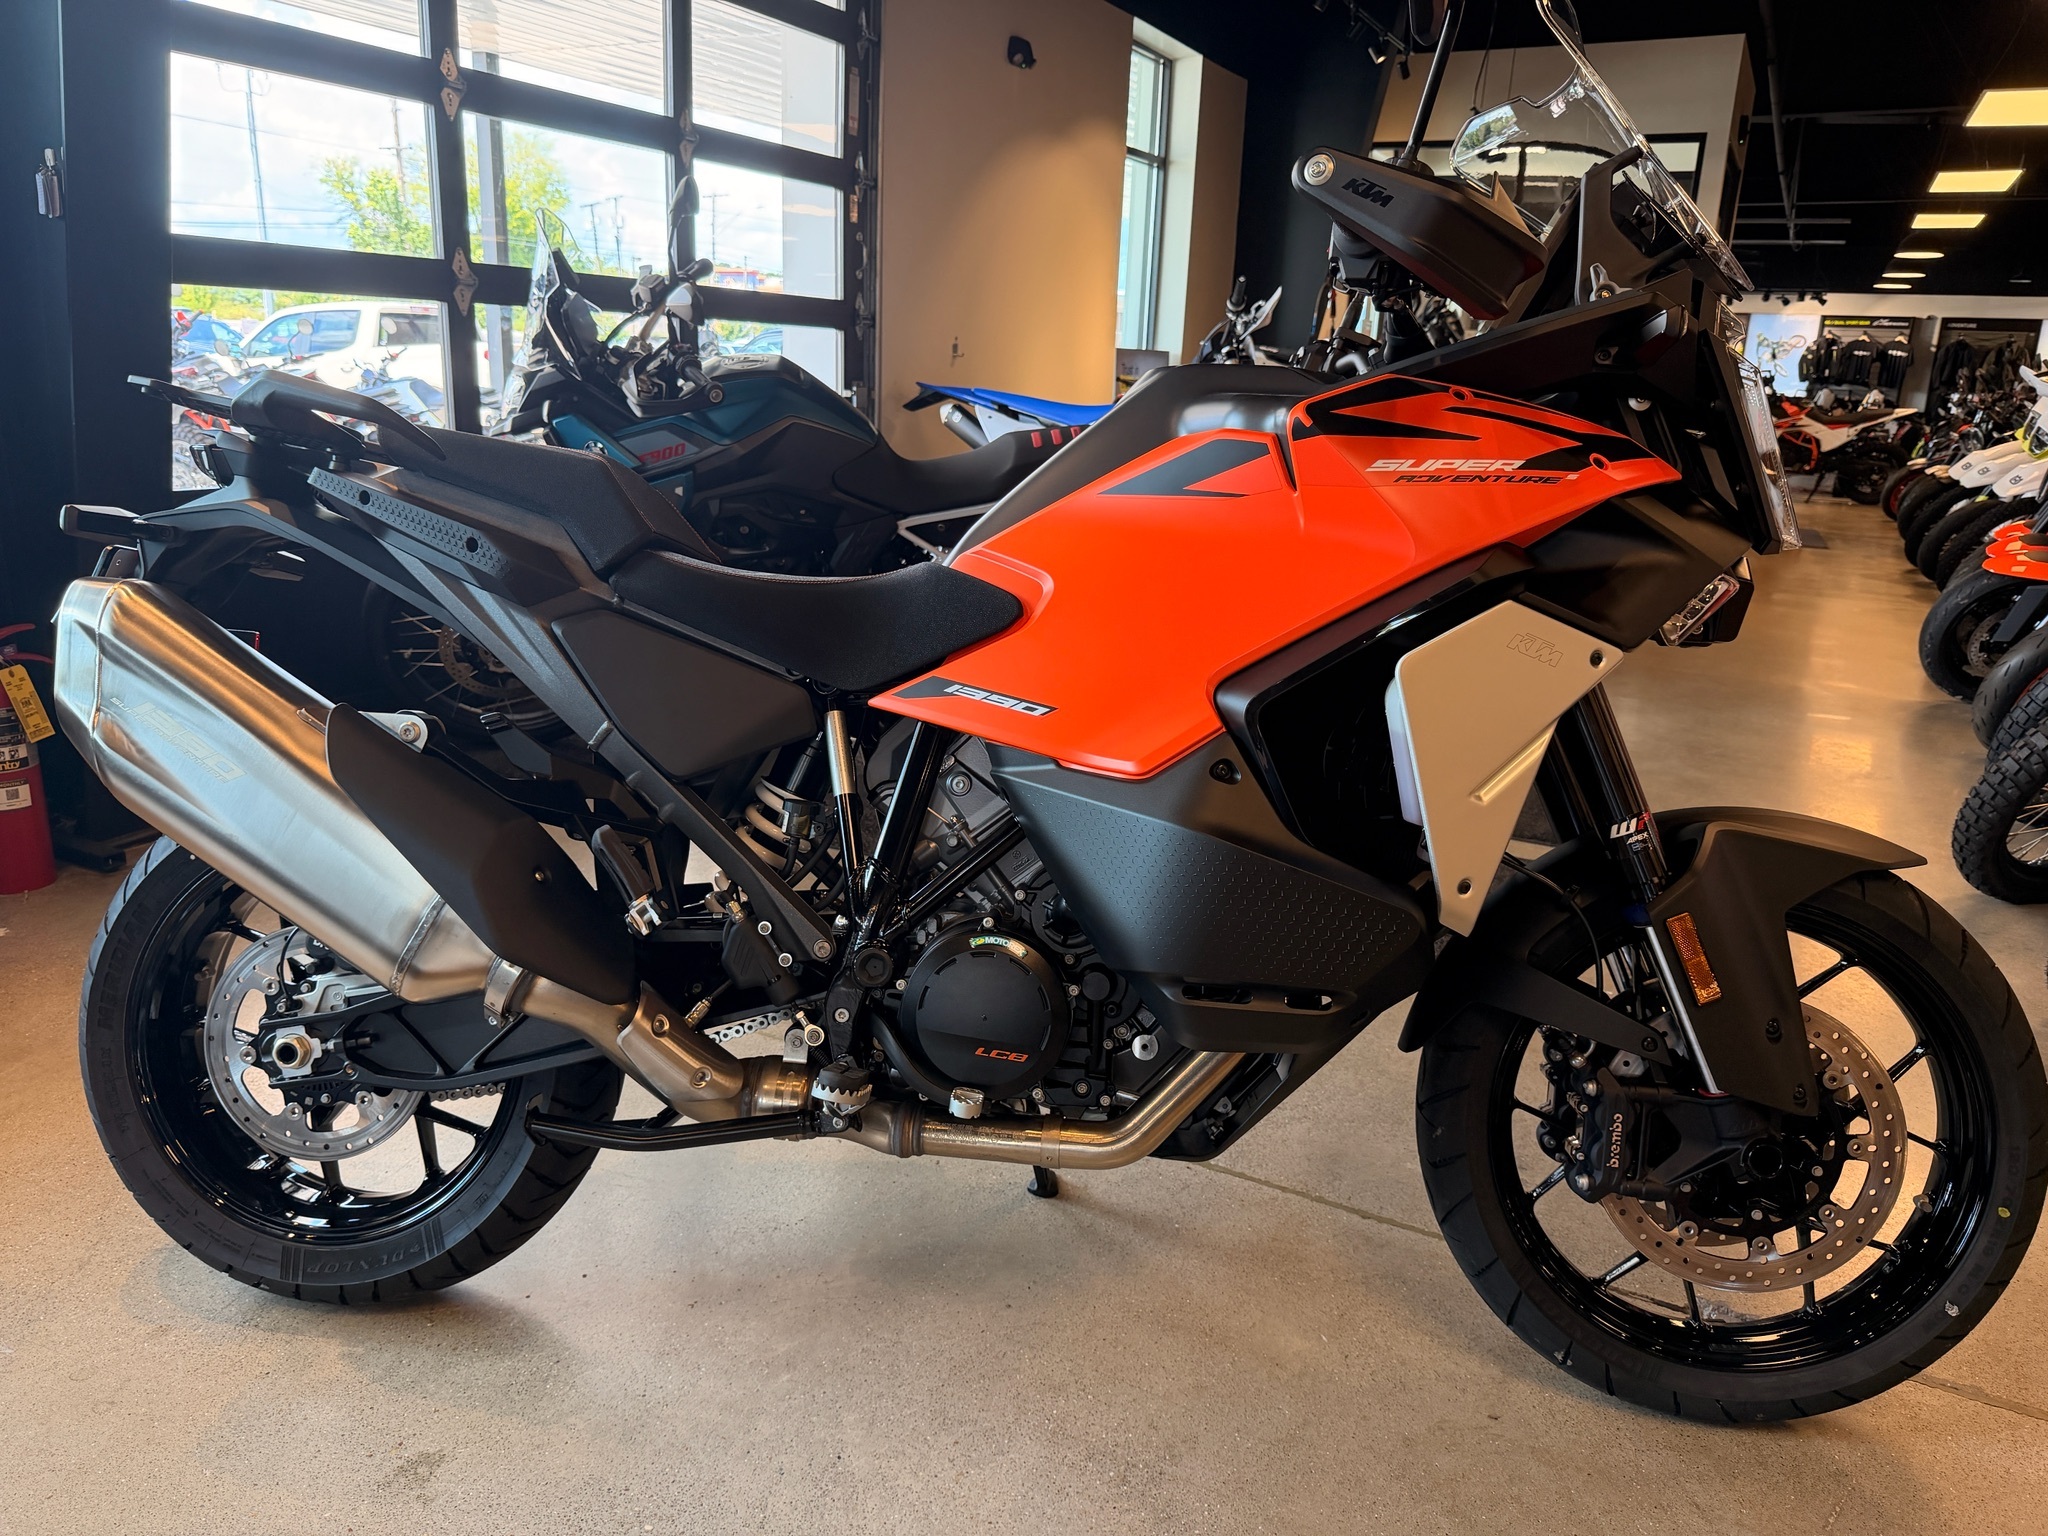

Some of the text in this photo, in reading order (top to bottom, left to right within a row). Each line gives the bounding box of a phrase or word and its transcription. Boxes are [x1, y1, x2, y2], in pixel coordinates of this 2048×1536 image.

[1341, 178, 1395, 208] KTM
[1365, 459, 1527, 472] SUPER
[1393, 474, 1564, 485] ADVENTURE
[1506, 632, 1564, 668] KTM
[943, 684, 1051, 716] 1390
[1626, 831, 1649, 844] APEX
[975, 1047, 1029, 1063] LC8
[1606, 1113, 1623, 1168] brembo
[306, 1249, 407, 1274] DUNLOP
